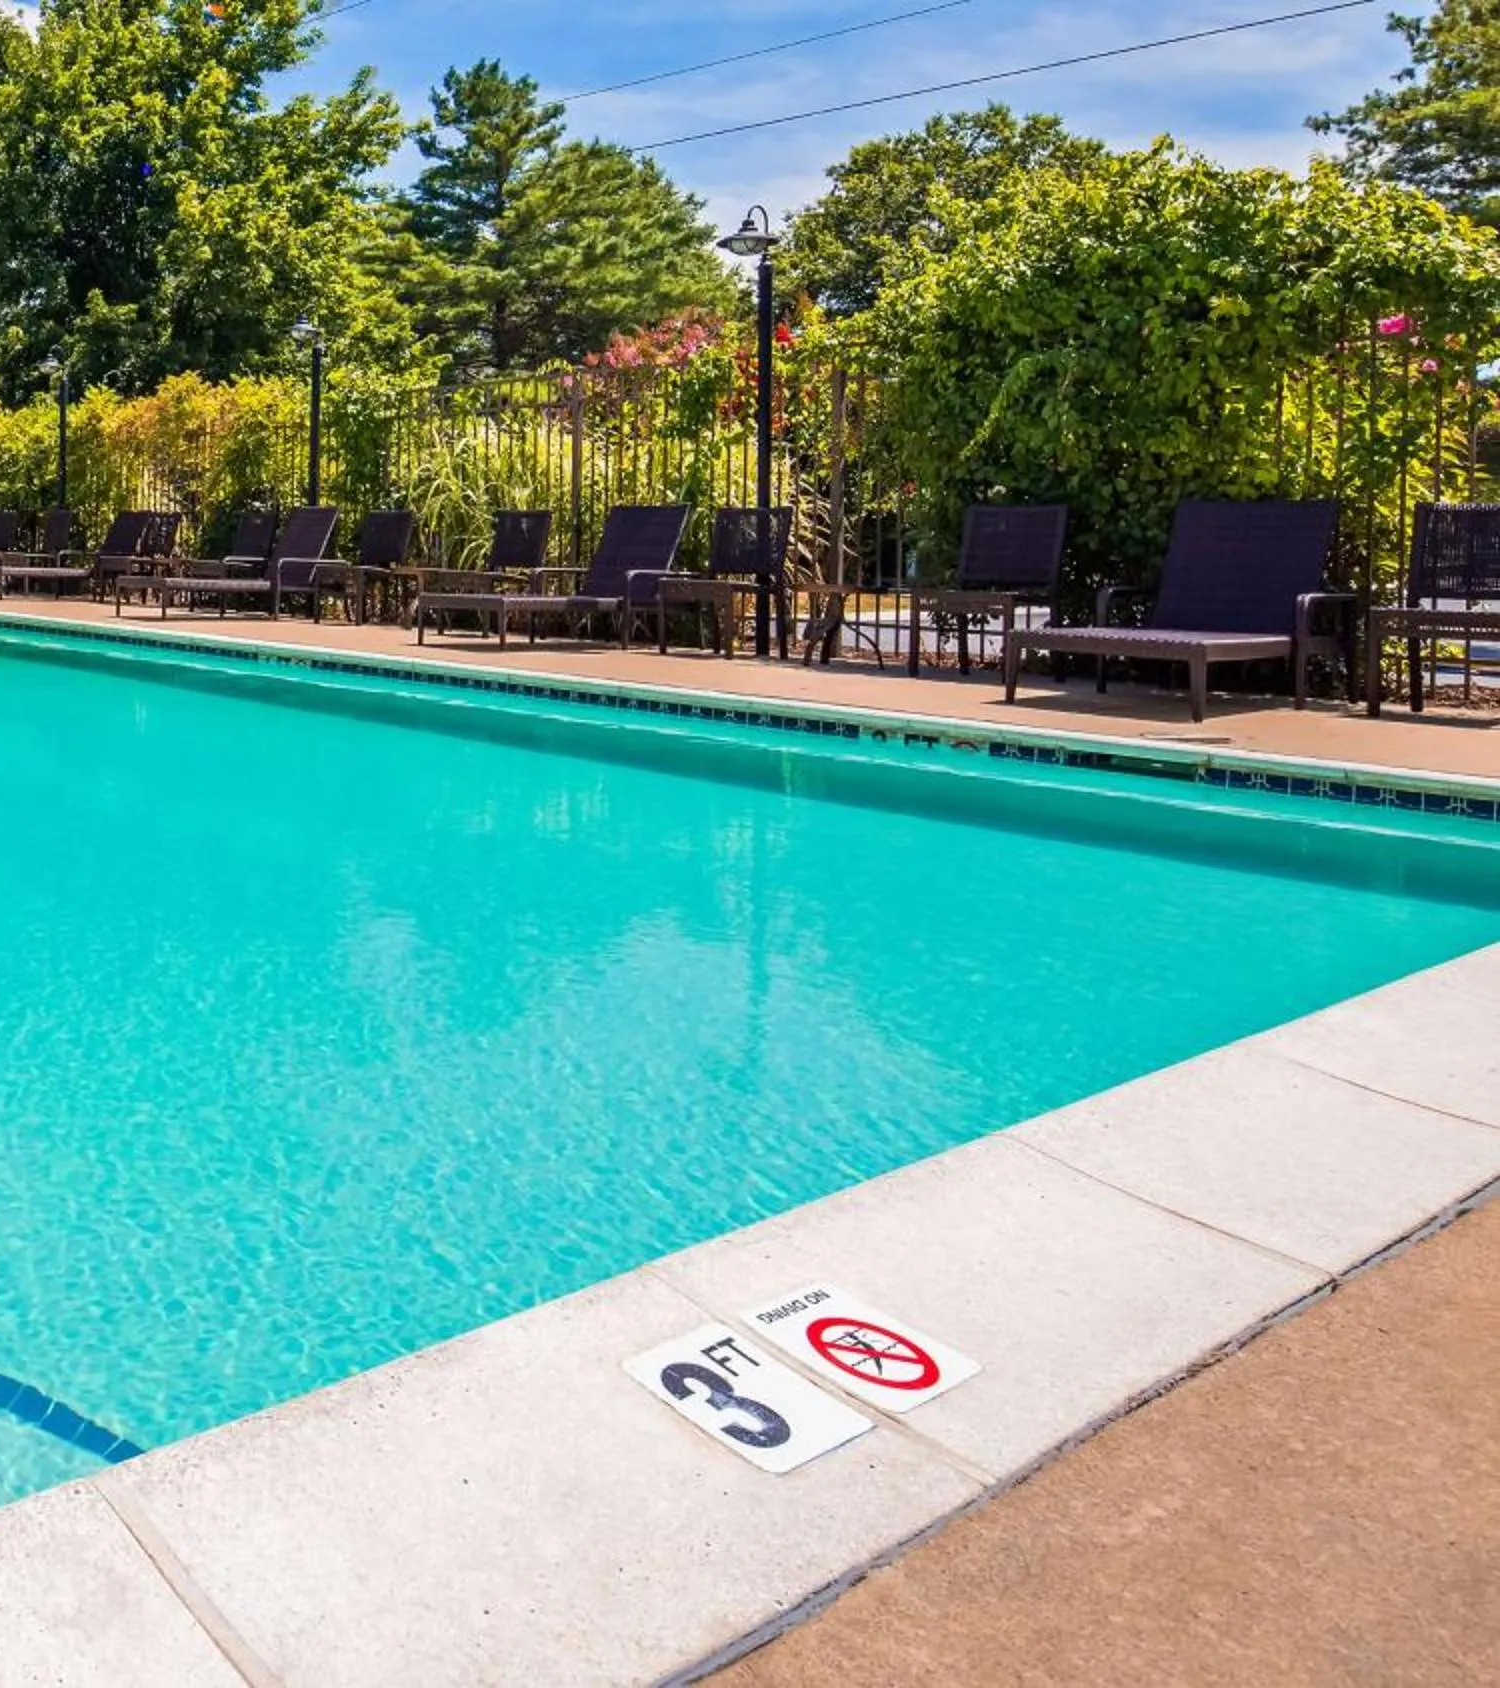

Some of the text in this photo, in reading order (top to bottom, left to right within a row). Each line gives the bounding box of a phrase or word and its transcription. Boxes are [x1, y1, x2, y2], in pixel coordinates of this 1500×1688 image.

[755, 1289, 831, 1325] NO DIVING
[661, 1337, 791, 1449] 3 FT
